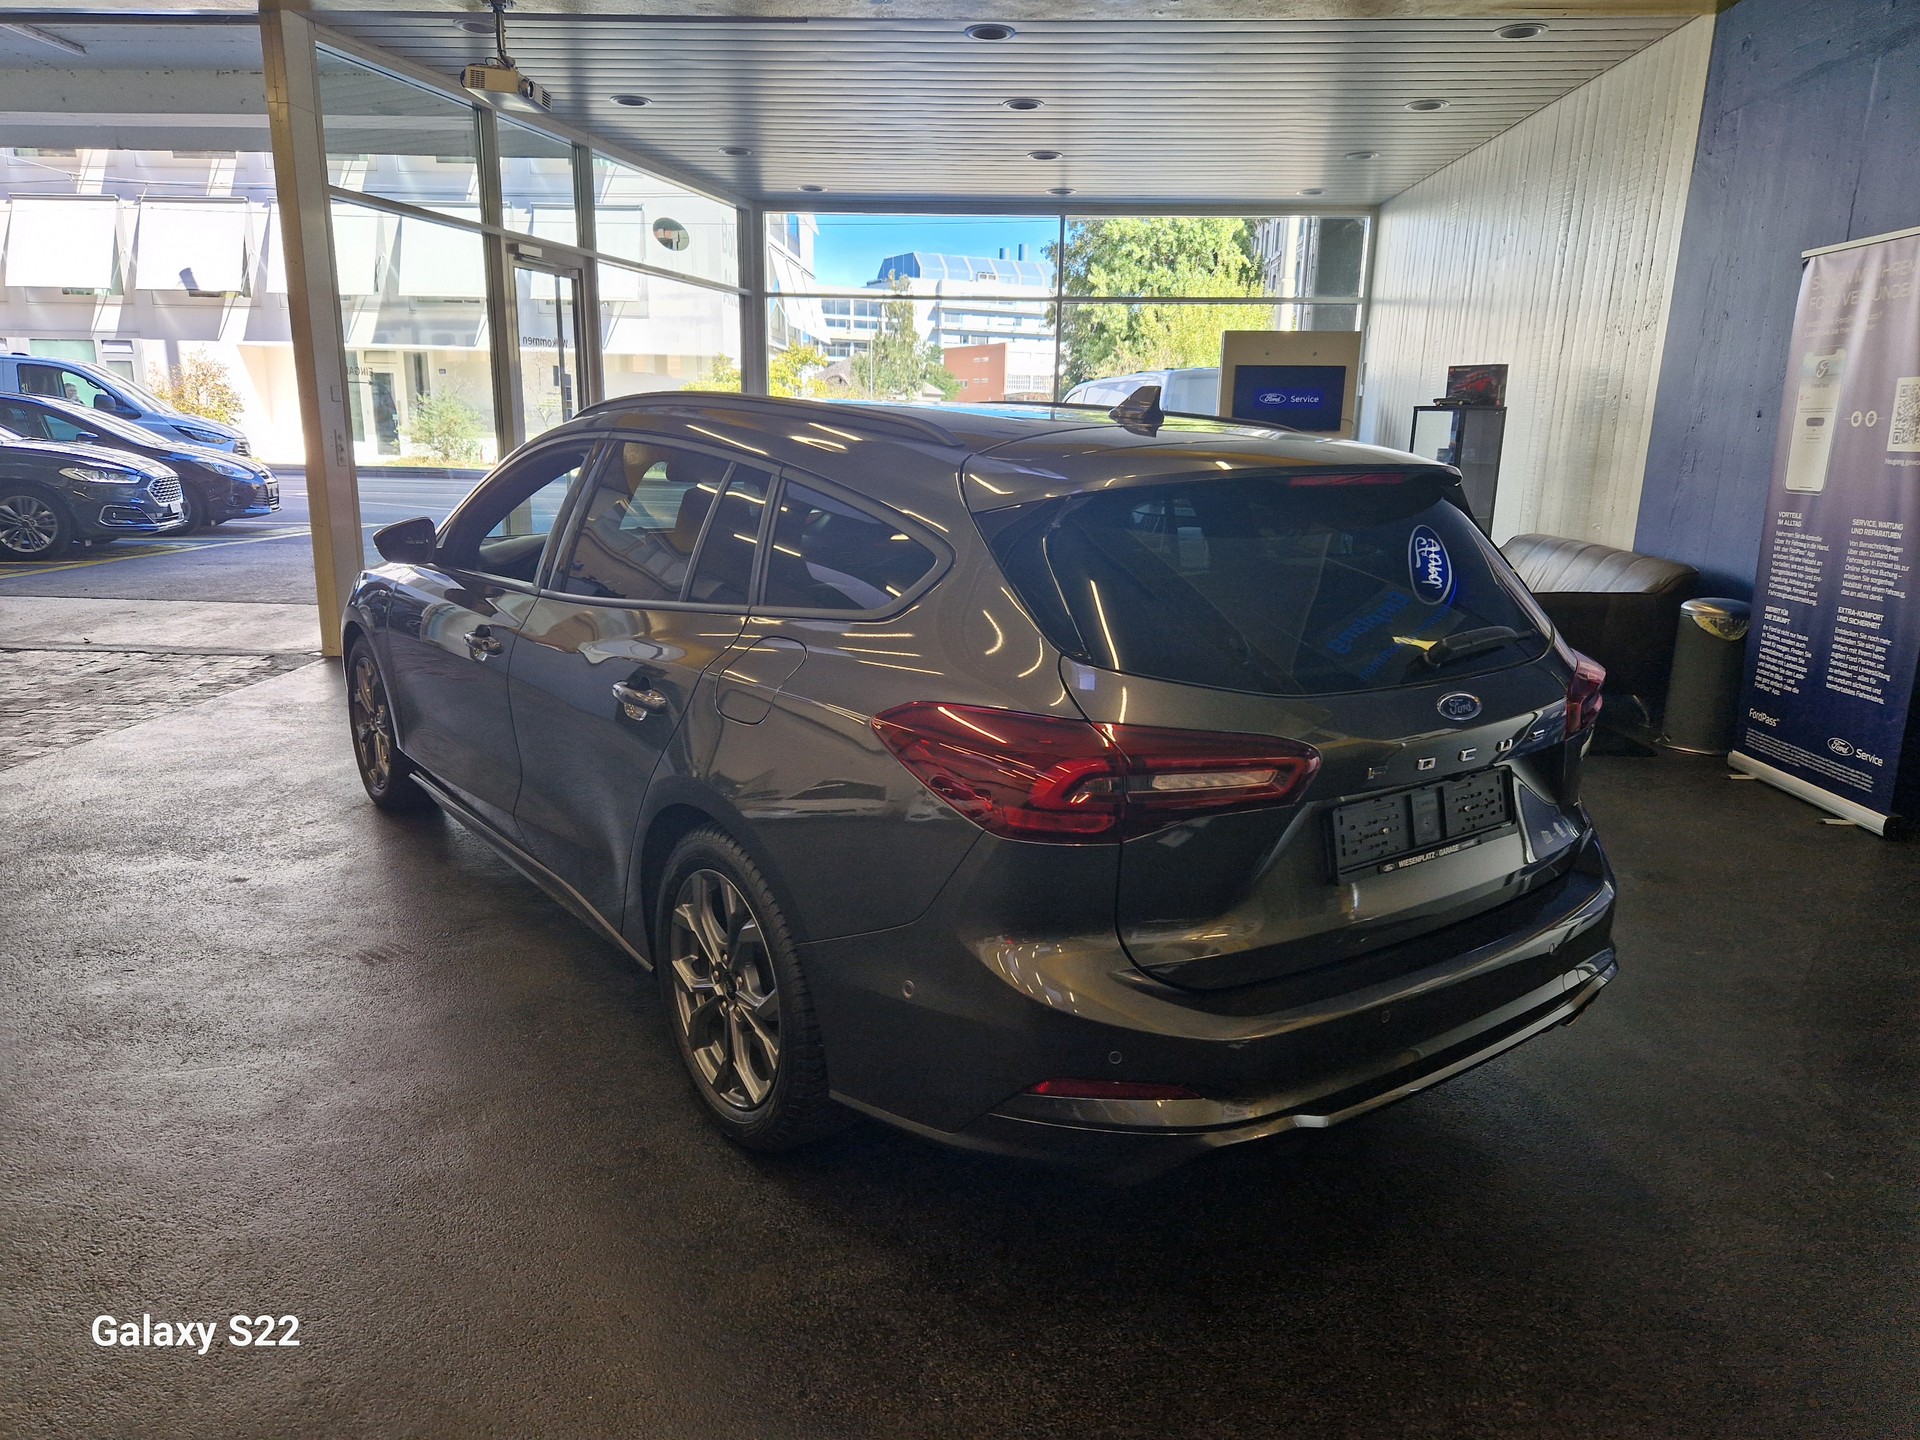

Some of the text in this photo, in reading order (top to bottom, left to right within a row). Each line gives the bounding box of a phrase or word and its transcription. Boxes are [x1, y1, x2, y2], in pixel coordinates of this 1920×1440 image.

[1261, 393, 1320, 404] Ford Service
[1778, 510, 1802, 519] VORTEILE
[1878, 521, 1904, 530] WARTUNG
[1864, 528, 1902, 539] REPARATUREN
[1860, 567, 1879, 575] Service
[1838, 606, 1884, 622] EXTRA-KOMFORT
[1848, 617, 1881, 629] SICHERHEIT
[1449, 699, 1473, 715] Ford
[1367, 729, 1546, 780] FOCUS
[1829, 738, 1884, 767] Ford Service
[1398, 851, 1436, 868] WIESENPLATZ
[1439, 844, 1460, 856] GARAGE
